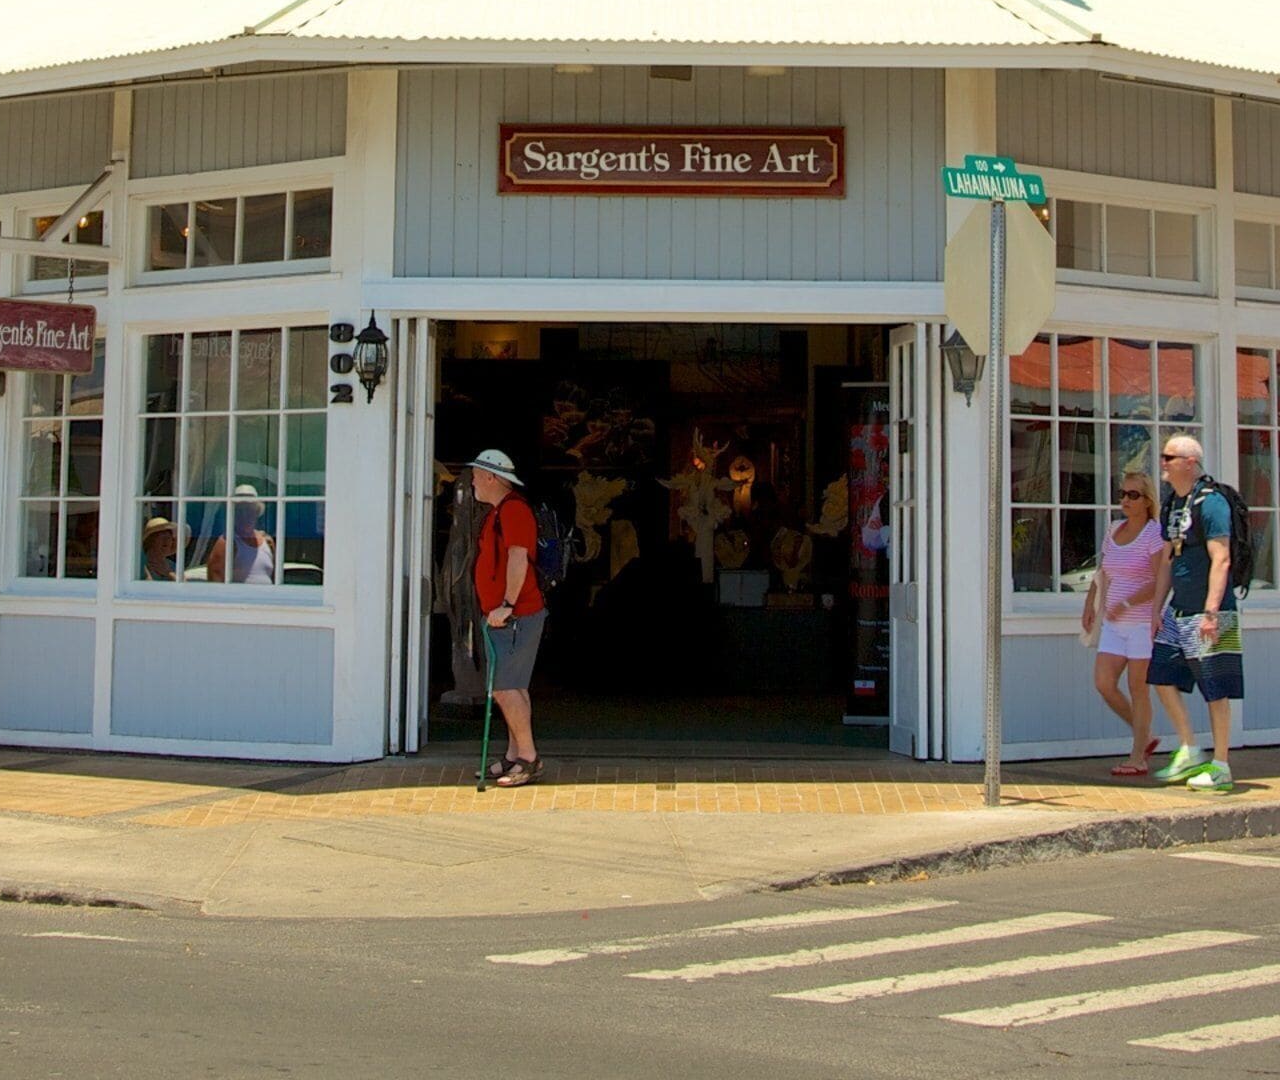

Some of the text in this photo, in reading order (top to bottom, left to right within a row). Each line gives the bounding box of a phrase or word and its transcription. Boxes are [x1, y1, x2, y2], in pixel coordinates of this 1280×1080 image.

[522, 141, 821, 181] Sargent's Fine Art
[947, 171, 1028, 200] LAHAINALUNA
[36, 320, 65, 349] Fine
[66, 322, 91, 351] Art
